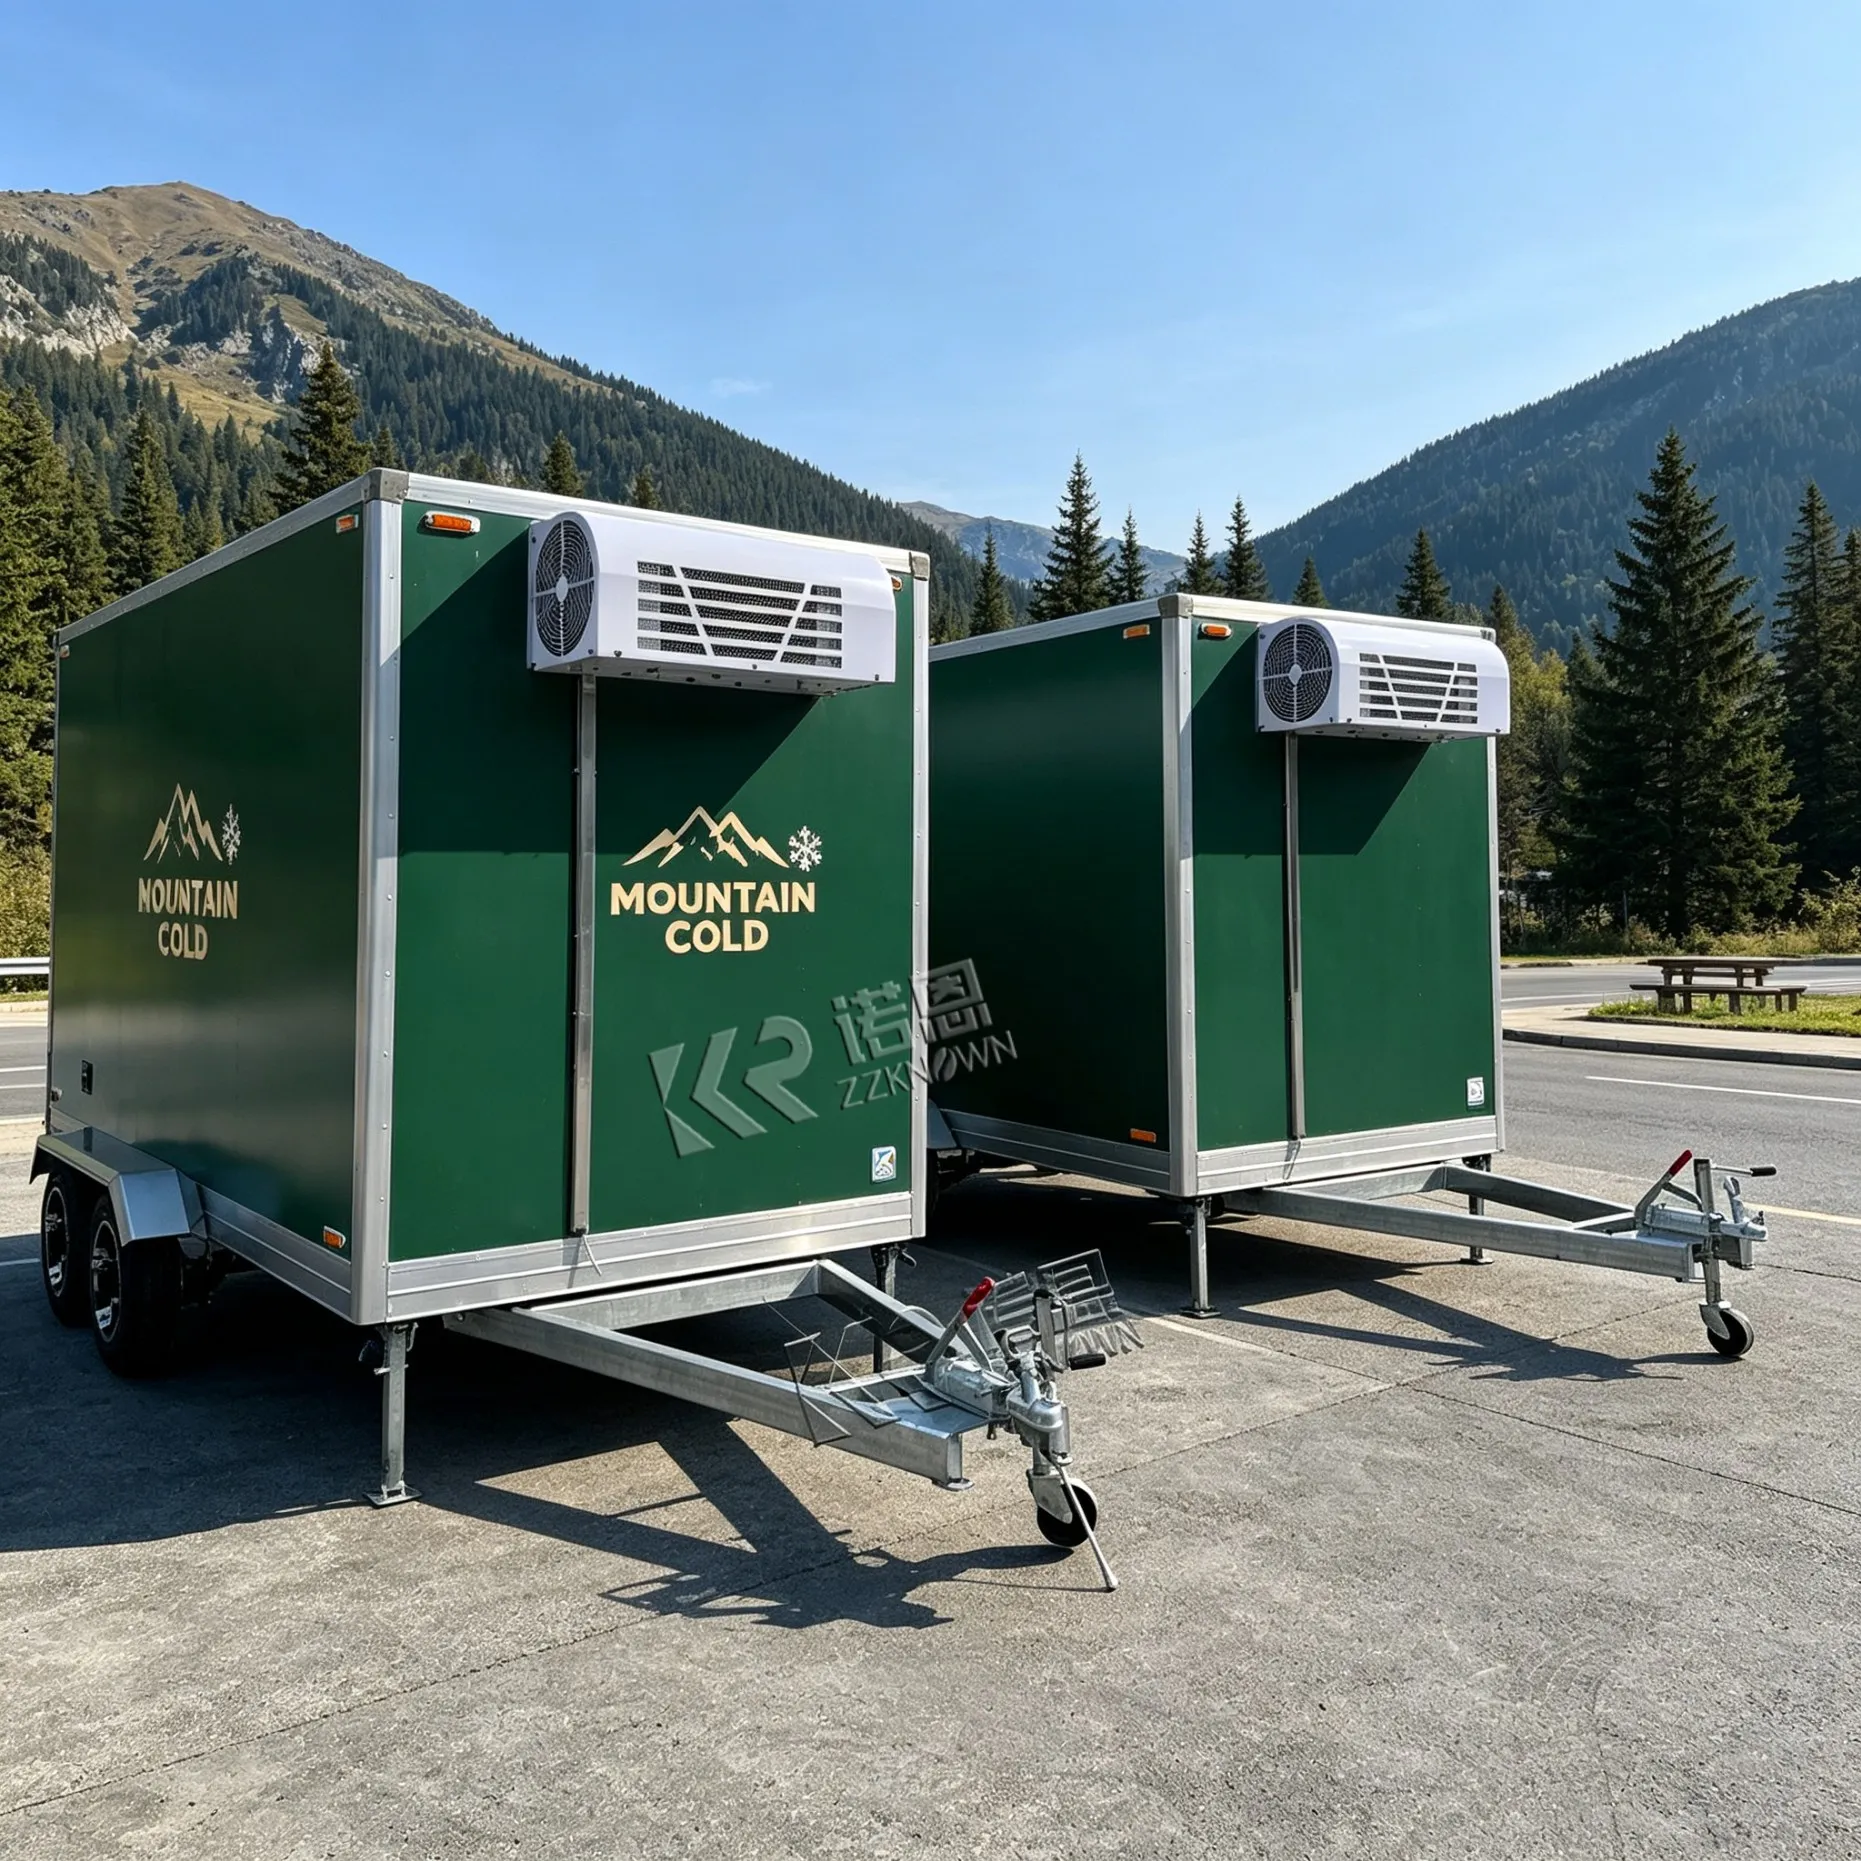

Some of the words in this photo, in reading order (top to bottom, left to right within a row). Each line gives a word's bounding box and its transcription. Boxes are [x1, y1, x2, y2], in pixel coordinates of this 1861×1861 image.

[138, 878, 238, 919] MOUNTAIN
[610, 881, 816, 916] MOUNTAIN
[158, 921, 208, 960] COLD
[665, 919, 769, 954] COLD
